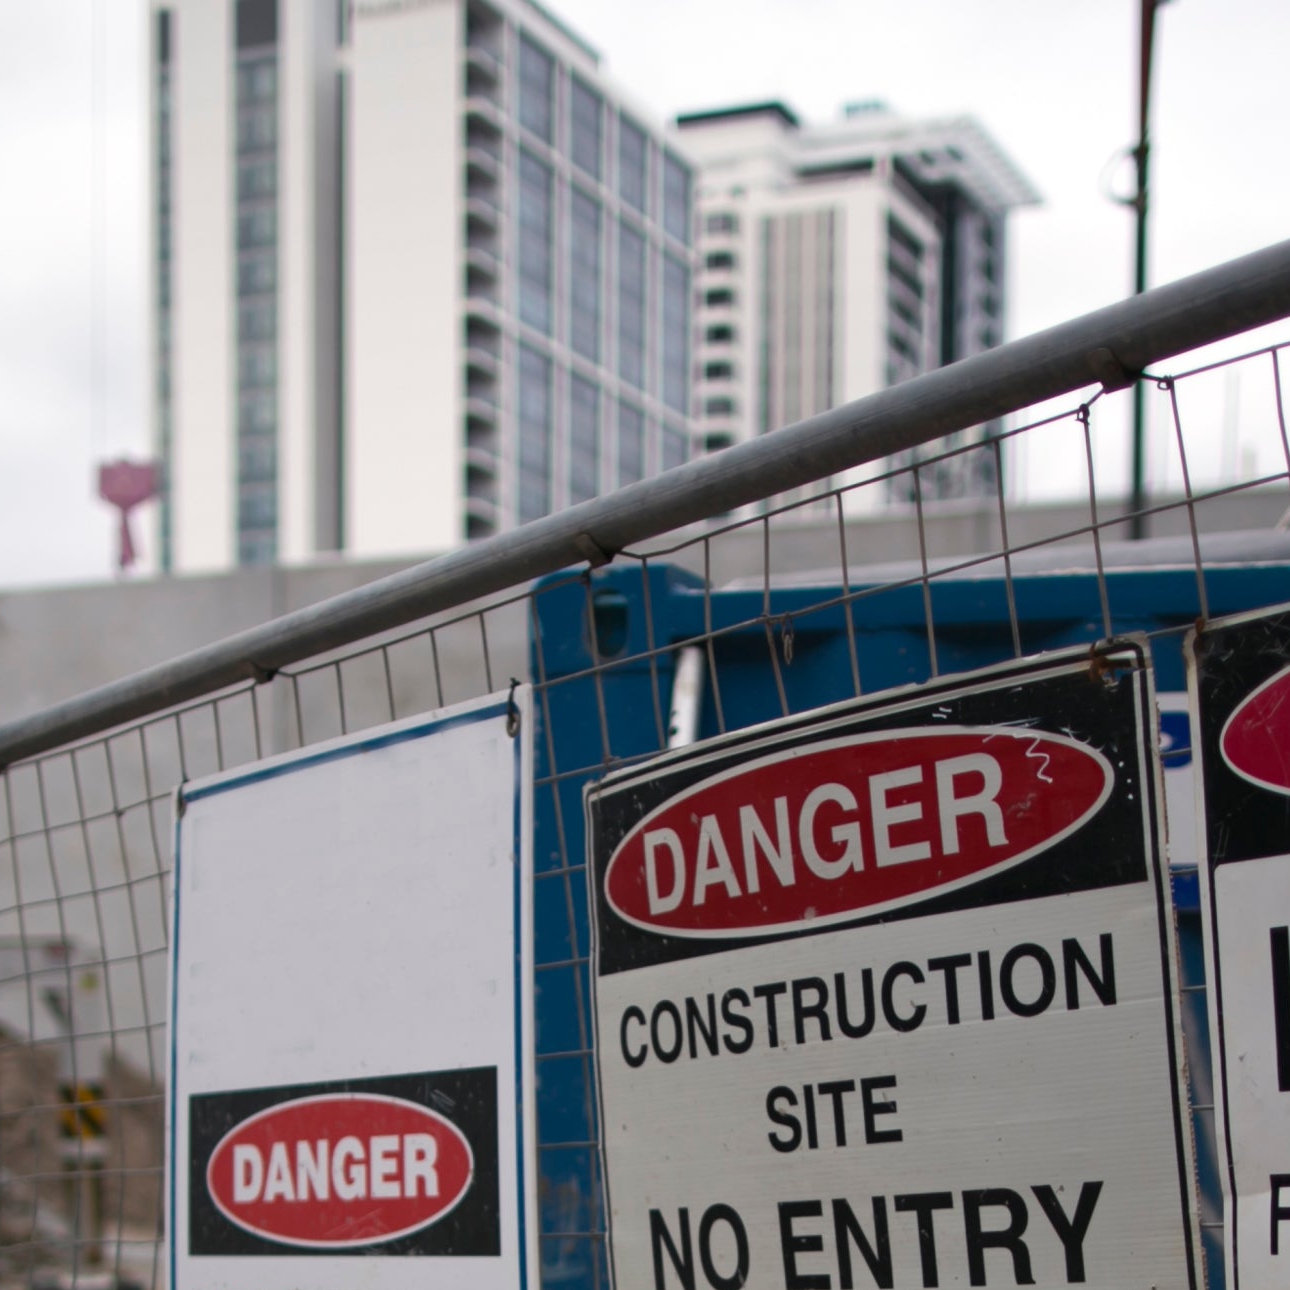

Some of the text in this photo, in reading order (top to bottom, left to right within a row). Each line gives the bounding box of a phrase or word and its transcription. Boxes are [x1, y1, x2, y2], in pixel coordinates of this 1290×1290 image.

[643, 752, 1008, 916] DANGER
[620, 933, 1117, 1068] CONSTRUCTION
[766, 1075, 903, 1152] SITE
[232, 1133, 438, 1203] DANGER
